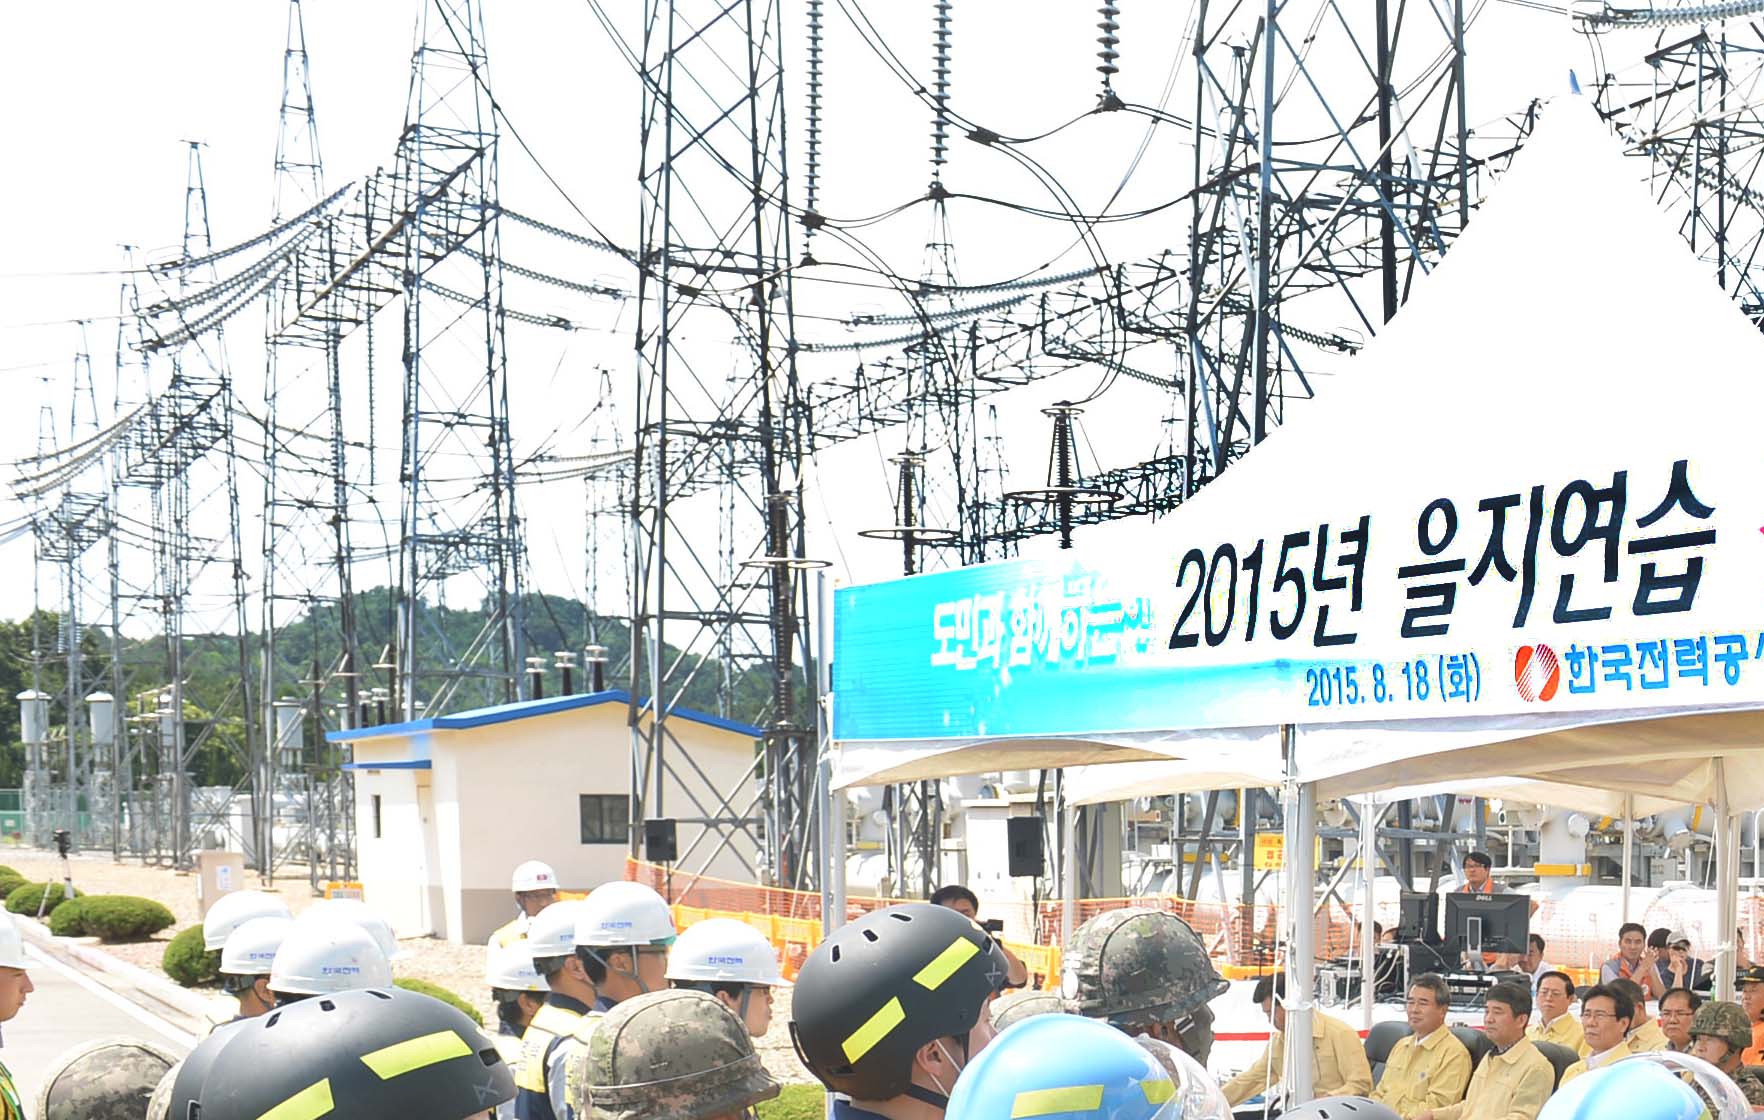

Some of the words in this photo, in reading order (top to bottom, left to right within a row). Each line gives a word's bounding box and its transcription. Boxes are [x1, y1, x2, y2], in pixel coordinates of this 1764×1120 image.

[1169, 514, 1369, 650] 2015년
[1399, 459, 1716, 640] 을지연습
[1306, 667, 1366, 707] 2015.
